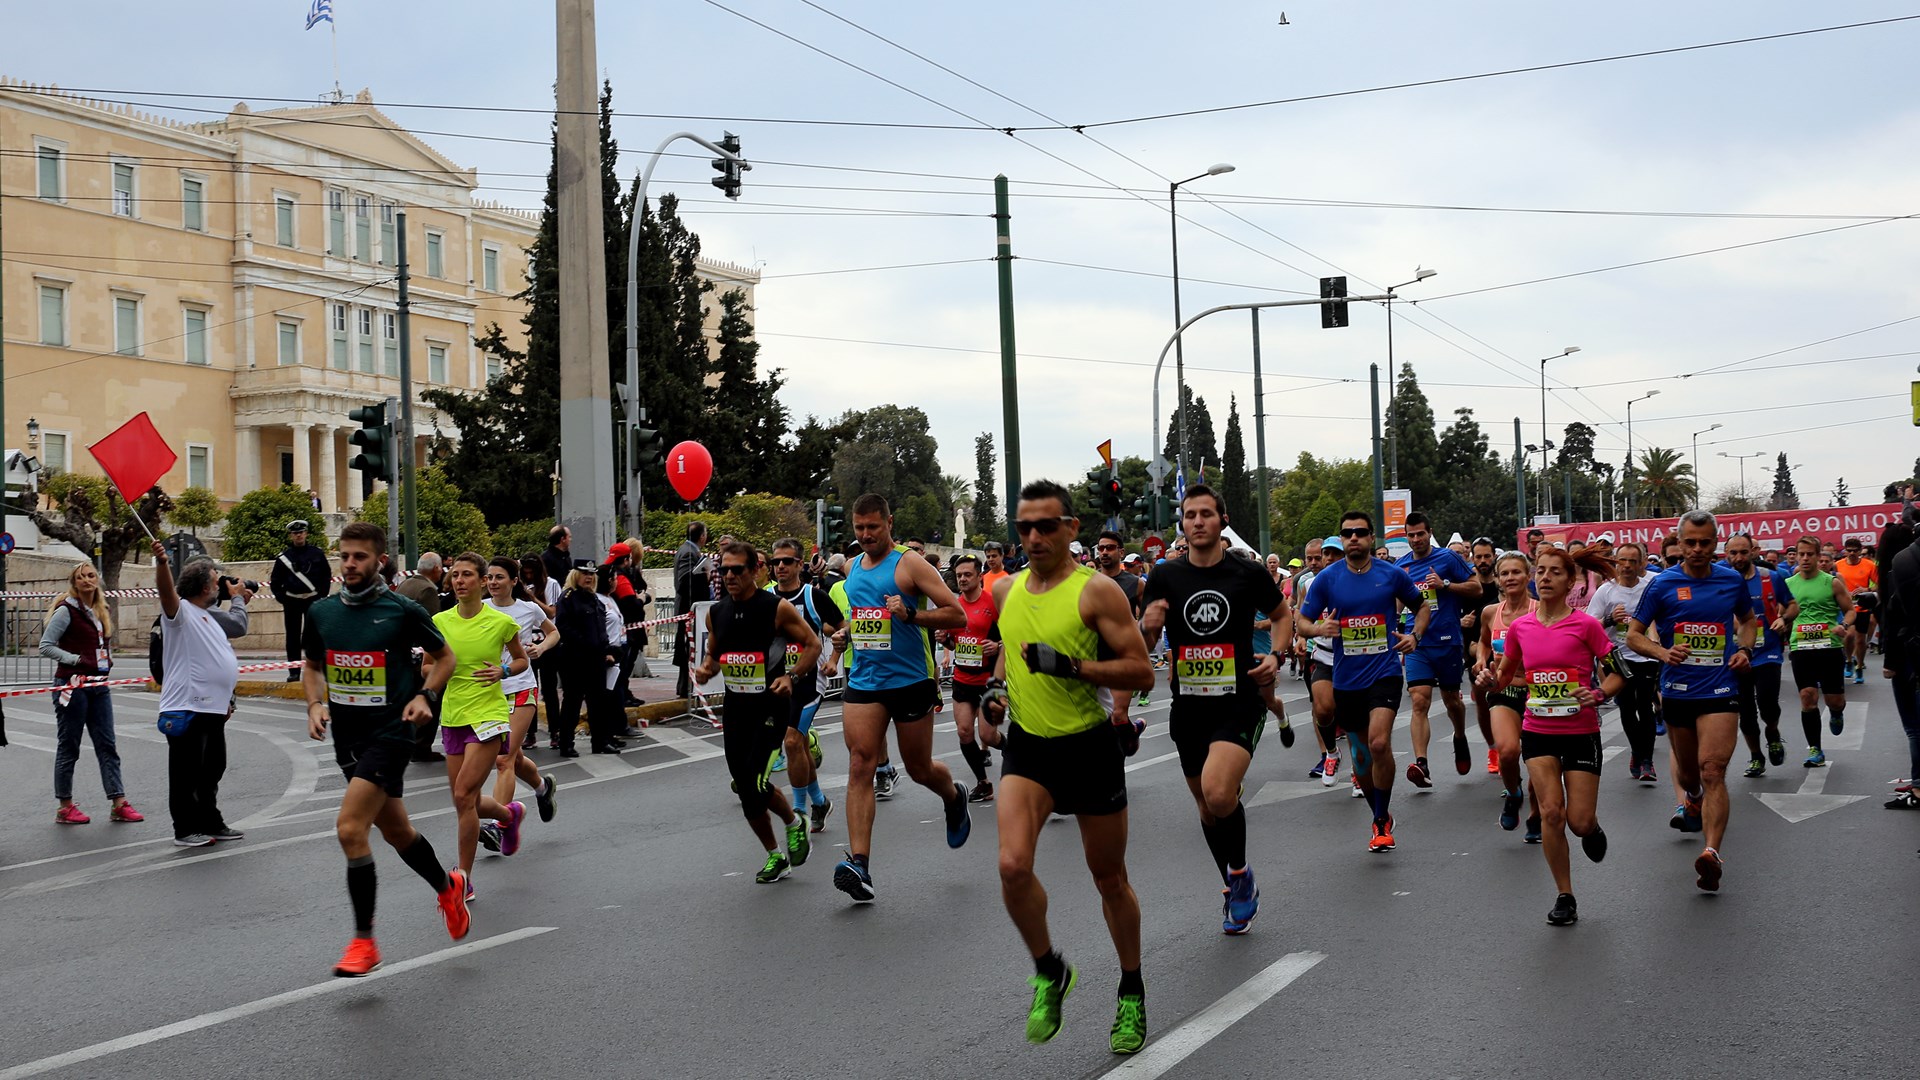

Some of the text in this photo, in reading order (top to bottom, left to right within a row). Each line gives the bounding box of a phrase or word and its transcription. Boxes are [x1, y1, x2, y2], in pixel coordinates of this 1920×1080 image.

[677, 454, 687, 474] i
[856, 609, 883, 619] ERGO
[1191, 603, 1220, 623] AR
[855, 620, 883, 634] 2459
[1348, 616, 1378, 628] ERGO
[1801, 624, 1823, 632] ERGO
[1352, 627, 1376, 640] 2511
[1683, 624, 1718, 635] ERGO
[957, 636, 978, 645] ERGO
[1682, 635, 1718, 649] 2039
[1802, 631, 1824, 641] 2861
[786, 644, 799, 654] GO
[957, 644, 978, 654] 2005
[1184, 646, 1224, 659] ERGO
[333, 653, 374, 667] ERGO
[726, 654, 756, 664] ERGO
[727, 665, 756, 677] 2367
[1185, 660, 1224, 677] 3959
[333, 667, 375, 685] 2044
[1532, 671, 1568, 683] ERGO
[1534, 684, 1569, 699] 3826
